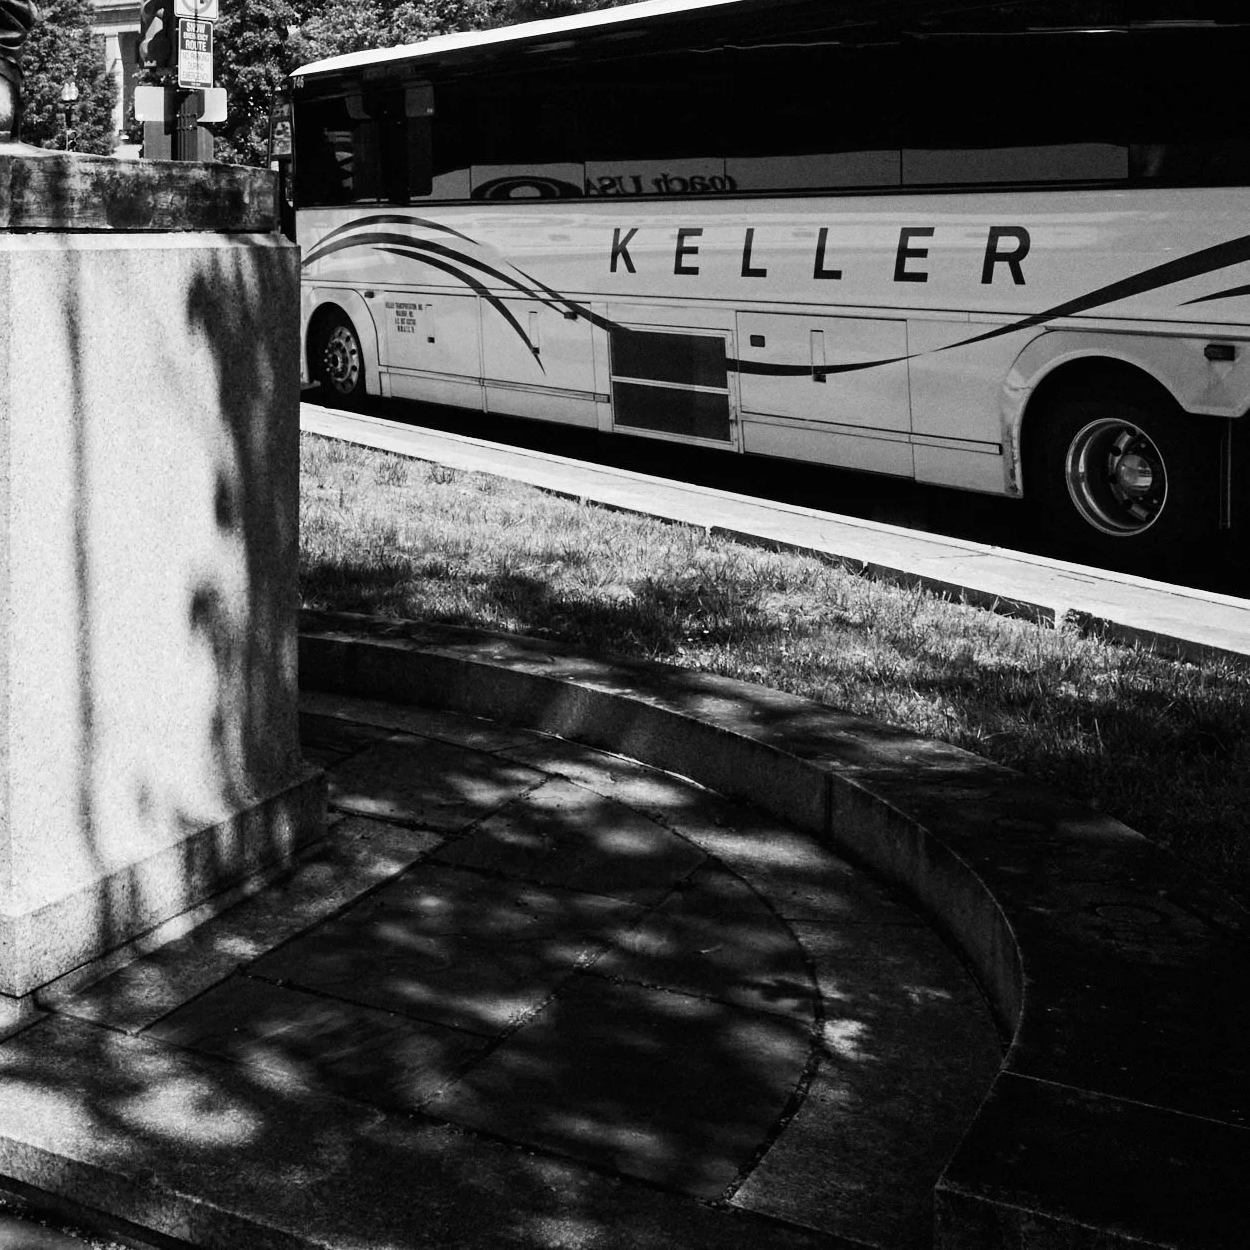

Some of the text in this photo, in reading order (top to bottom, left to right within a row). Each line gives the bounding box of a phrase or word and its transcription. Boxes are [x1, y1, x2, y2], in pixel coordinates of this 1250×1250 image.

[186, 21, 206, 34] SNOW
[185, 39, 207, 52] ROUTE
[609, 225, 1031, 286] KELLER
